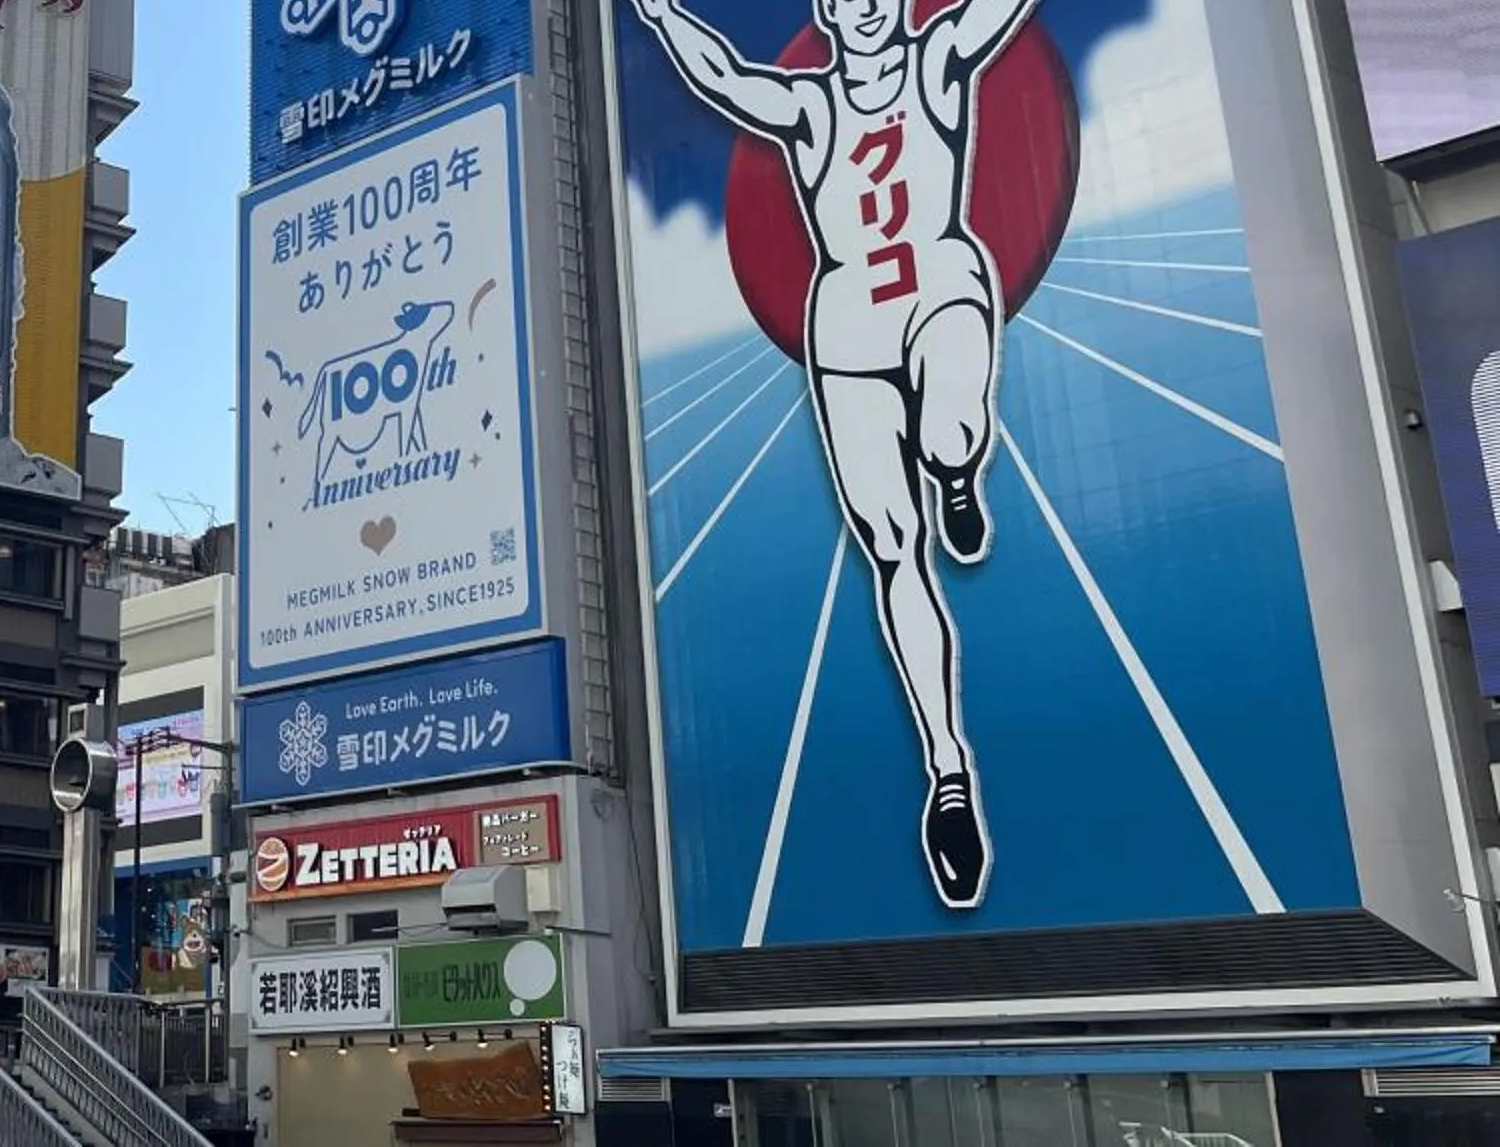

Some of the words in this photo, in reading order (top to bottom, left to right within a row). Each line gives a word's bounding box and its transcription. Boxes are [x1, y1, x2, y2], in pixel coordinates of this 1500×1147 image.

[280, 28, 472, 146] 雪印メグミルク
[271, 146, 484, 264] 創業100周年
[847, 109, 920, 306] グリコ
[298, 220, 457, 314] ありがとう
[331, 346, 458, 423] 100th
[302, 447, 461, 512] Anniversary
[259, 627, 298, 647] 100th
[426, 576, 515, 613] SINCE1925
[287, 579, 355, 612] MEGMILK
[363, 567, 411, 594] SNOW
[417, 551, 477, 581] BRAND
[345, 700, 376, 720] Love
[380, 690, 423, 714] Earth.
[429, 684, 461, 705] Love
[464, 677, 498, 699] Life.
[337, 708, 512, 772] 雪印メグミルク
[295, 836, 457, 887] ZETTERIA
[501, 844, 540, 859] コーヒー
